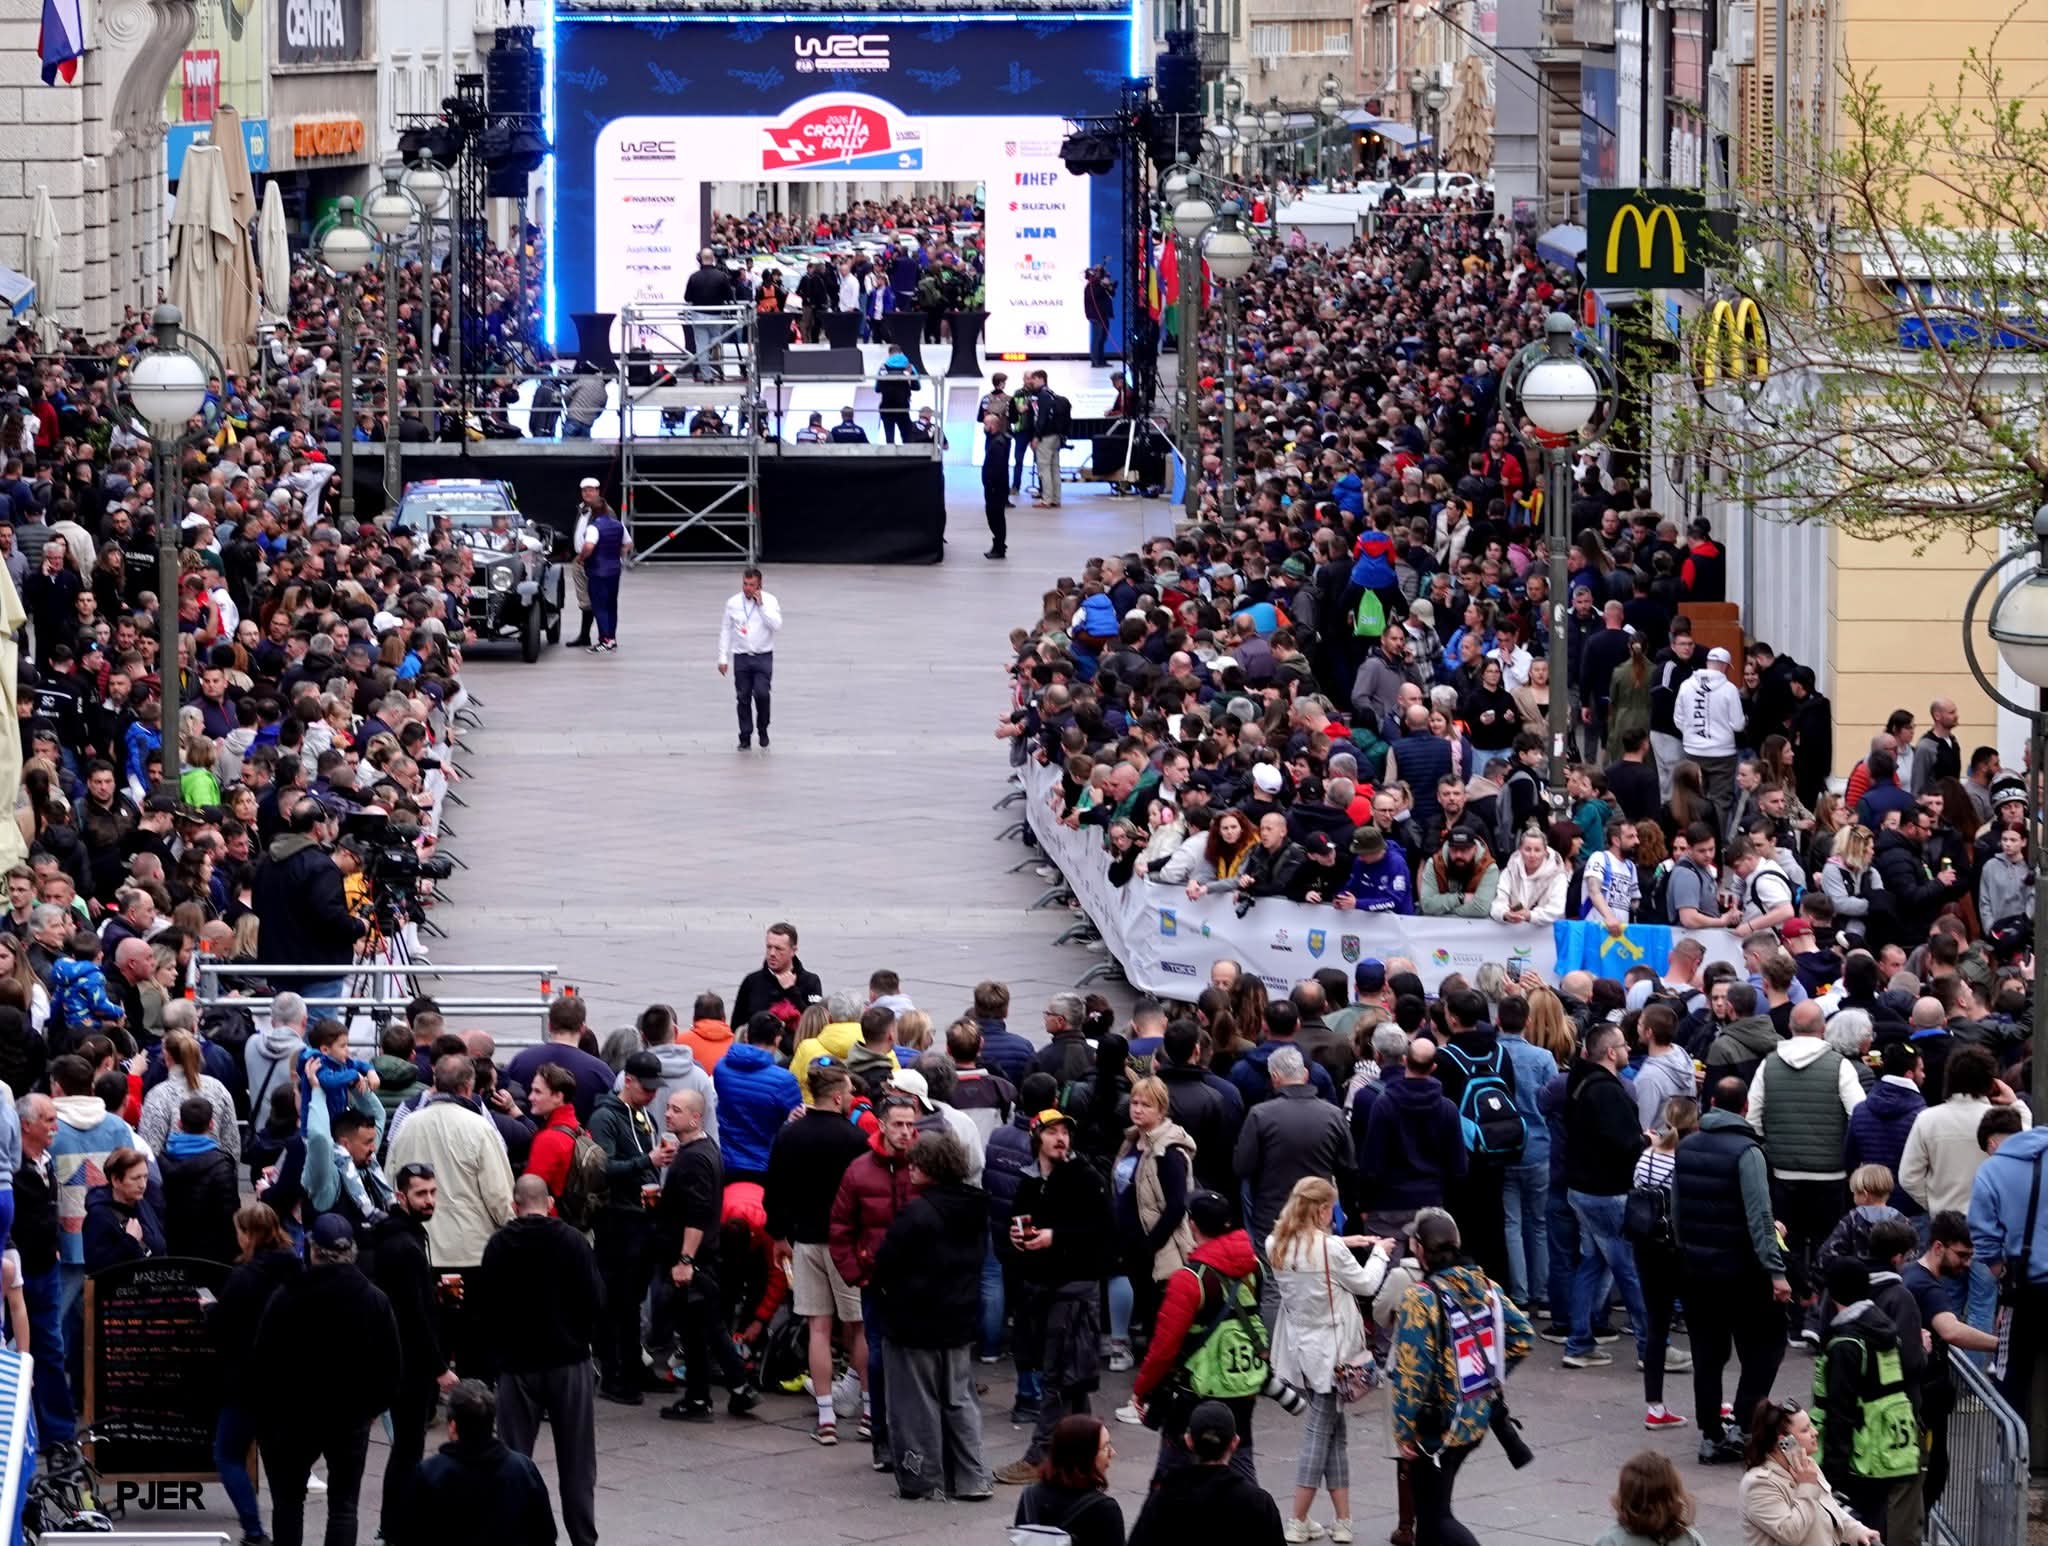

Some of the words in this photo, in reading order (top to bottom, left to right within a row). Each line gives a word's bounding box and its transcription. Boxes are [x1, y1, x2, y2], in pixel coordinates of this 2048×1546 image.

[285, 0, 345, 48] CENTRA
[794, 34, 890, 57] WRC
[803, 123, 870, 137] CROATIA
[620, 141, 676, 153] WRC
[821, 137, 868, 150] RALLY
[1030, 172, 1059, 186] HEP
[1021, 202, 1066, 211] SUZUKI
[1009, 299, 1064, 307] VALAMAR
